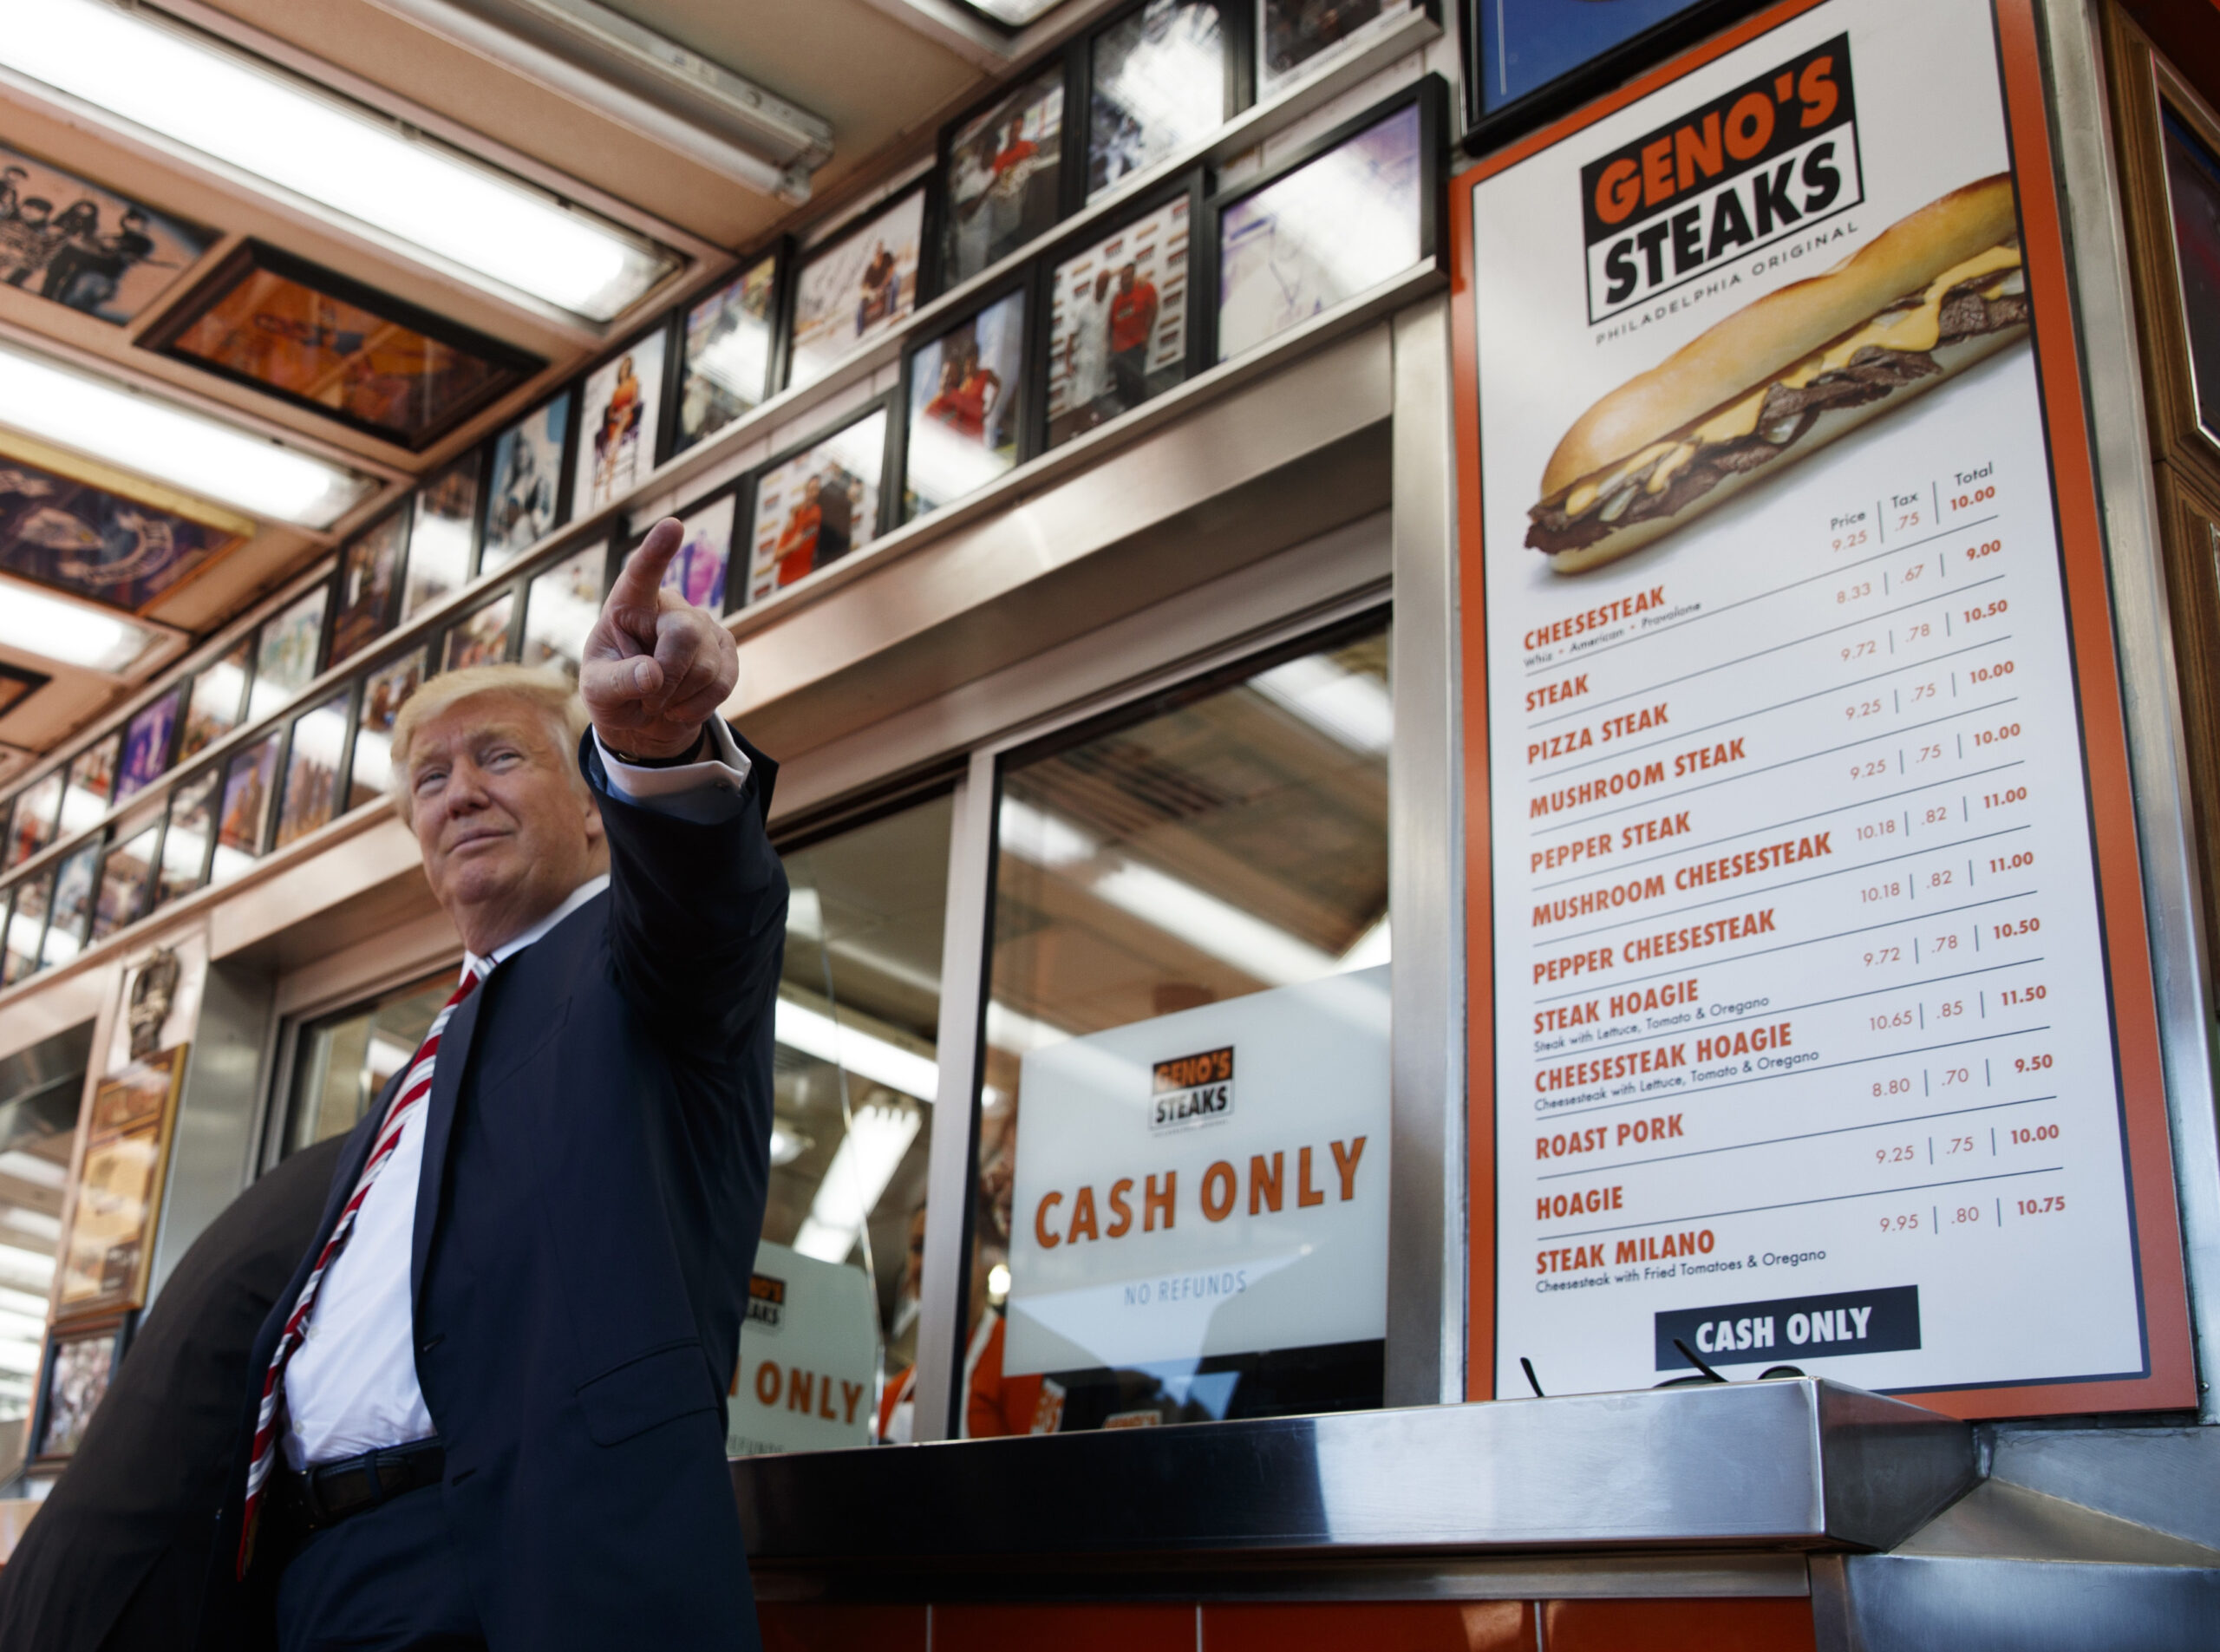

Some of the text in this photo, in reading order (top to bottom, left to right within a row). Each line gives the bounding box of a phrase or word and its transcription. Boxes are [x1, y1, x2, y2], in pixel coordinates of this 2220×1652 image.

[1595, 56, 1839, 224] GENO'S
[1604, 141, 1841, 304] STEAKS
[1596, 222, 1858, 345] PHILADELPHIA ORIGINAL
[1830, 461, 1994, 531] Price Tax Total
[1832, 486, 1995, 552] 9.25 .75 10.00
[1836, 539, 2001, 604] 8.33 .67 9.00
[1523, 602, 1701, 668] Whiz American Provolone
[1524, 585, 1665, 651] CHEESESTEAK
[1840, 599, 2008, 662] 9.72 .78 10.50
[1525, 674, 1589, 712] STEAK
[1845, 660, 2014, 721] 9.25 .75 10.00
[1527, 702, 1668, 765] PIZZA STEAK
[1850, 722, 2021, 780] 9.25 .75 10.00
[1530, 737, 1746, 819] MUSHROOM STEAK
[1531, 811, 1691, 873] PEPPER STEAK
[1857, 786, 2027, 841] 10.18 .82 11.00
[1532, 831, 1832, 928] MUSHROOM CHEESESTEAK
[1861, 851, 2034, 903] 10.18 .82 11.00
[1533, 908, 1776, 985] PEPPER CHEESESTEAK
[1863, 917, 2040, 967] 9.72 .78 10.50
[1533, 978, 1699, 1035] STEAK HOAGIE
[1534, 997, 1770, 1053] Steak with Lettuce, Tomato & Oregano
[1869, 984, 2047, 1031] 10.65 .85 11.50
[1156, 1049, 1231, 1092] GENO'S
[1534, 1051, 1819, 1112] Cheesesteak with Lettuce, Tomato & Oregano
[1535, 1022, 1792, 1093] CHEESESTEAK HOAGIE
[1872, 1054, 2054, 1098] 8.80 .70 9.50
[1156, 1085, 1227, 1124] STEAKS
[1536, 1113, 1684, 1160] ROAST PORK
[1875, 1124, 2060, 1165] 9.25 .75 10.00
[1035, 1135, 1368, 1250] CASH ONLY
[1537, 1185, 1623, 1221] HOAGIE
[1879, 1195, 2066, 1232] 9.95 .80 10.75
[1535, 1250, 1826, 1294] Cheesesteak with Fried Tomatoes & Oregano
[1537, 1229, 1715, 1275] STEAK MILANO
[1123, 1269, 1248, 1307] NO REFUNDS
[1695, 1306, 1872, 1354] CASH ONLY
[754, 1360, 865, 1427] ONLY
